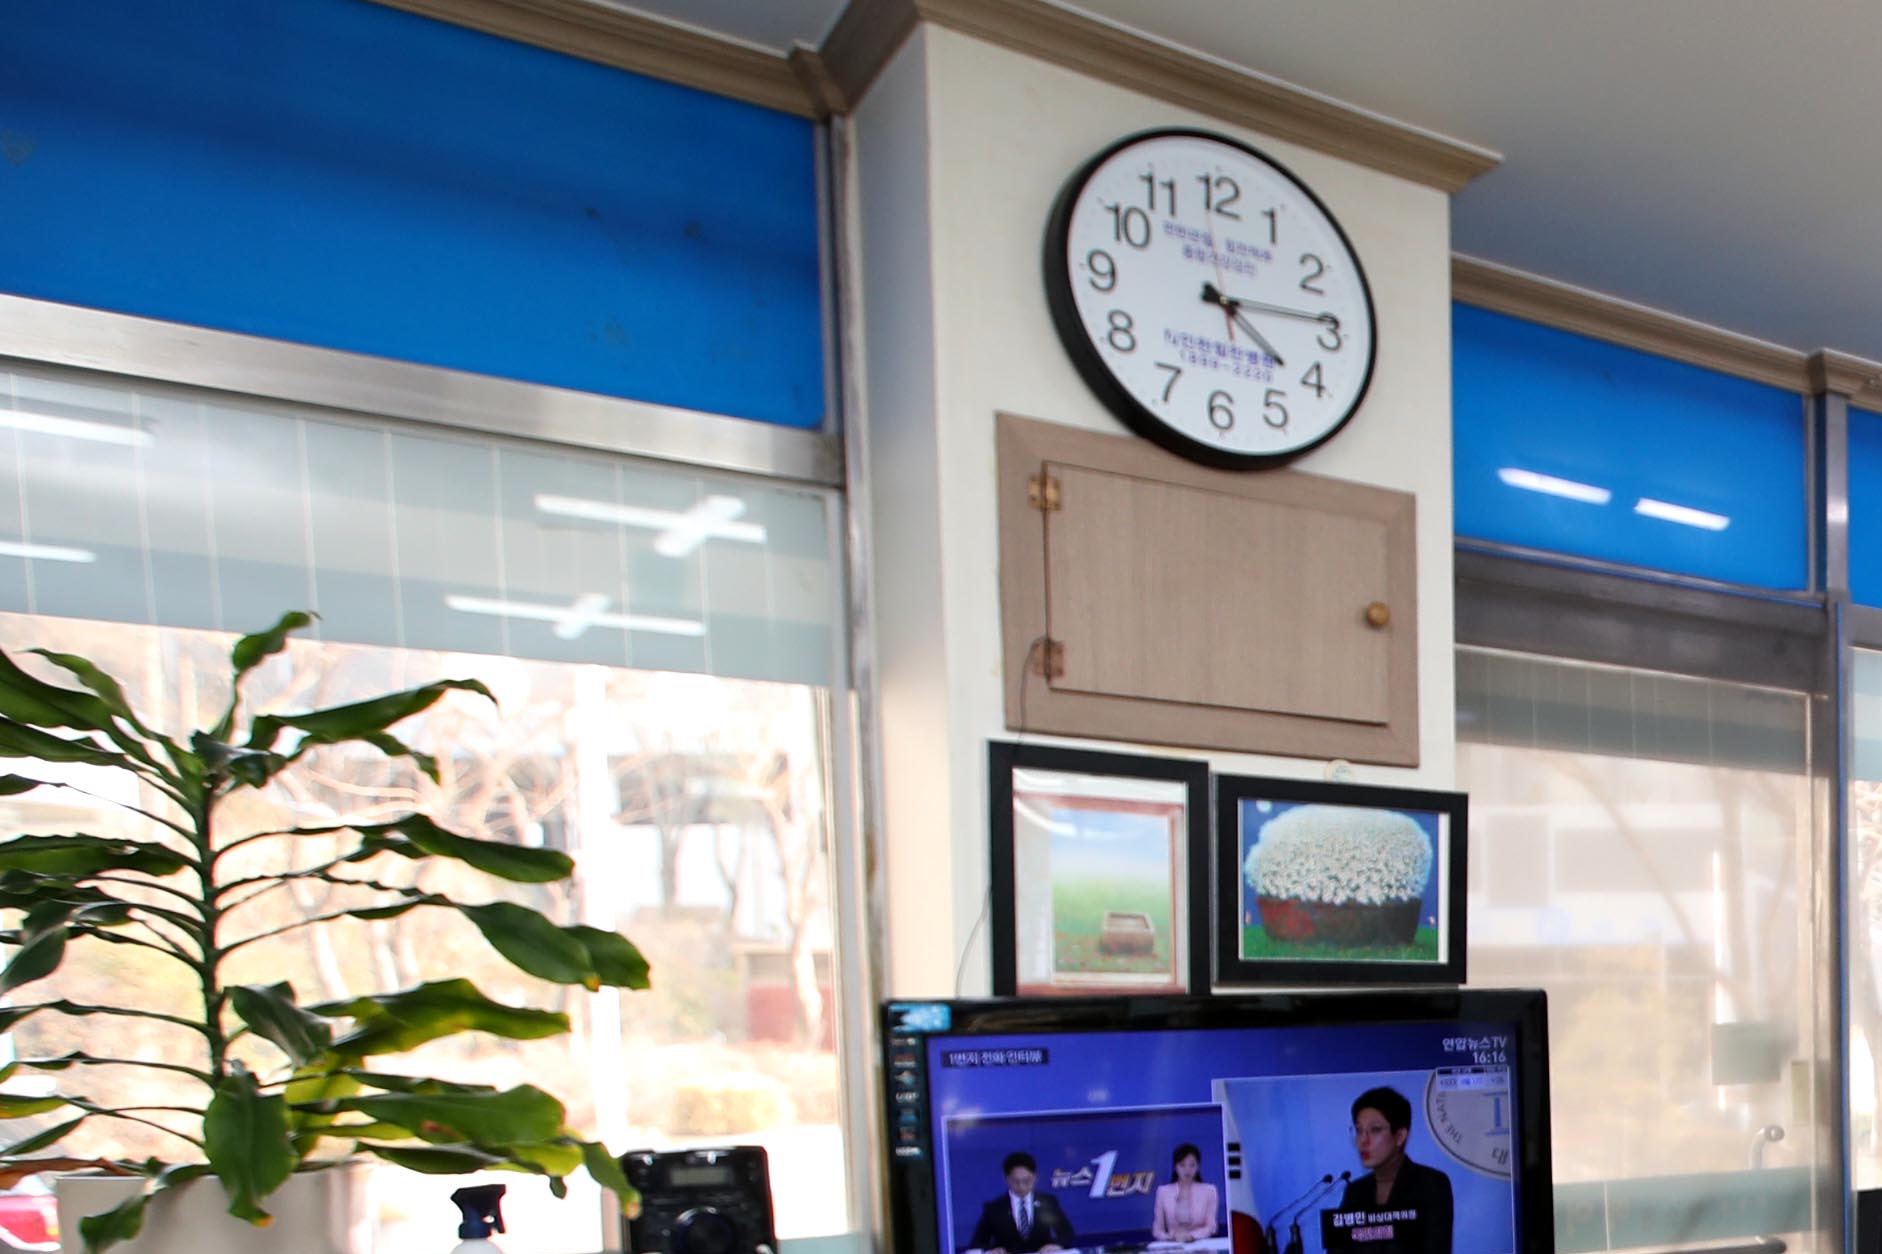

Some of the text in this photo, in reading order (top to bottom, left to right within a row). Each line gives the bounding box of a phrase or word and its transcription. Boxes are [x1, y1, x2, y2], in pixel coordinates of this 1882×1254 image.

[1140, 171, 1176, 217] 11
[1197, 171, 1241, 220] 12
[1105, 202, 1151, 248] 10
[1262, 208, 1277, 245] 1
[1088, 249, 1117, 293] 9
[1300, 254, 1325, 295] 2
[1108, 309, 1136, 352] 8
[1317, 312, 1342, 351] 3
[1155, 361, 1183, 403] 7
[1300, 362, 1327, 398] 4
[1208, 390, 1234, 431] 6
[1263, 389, 1288, 429] 5
[1442, 1036, 1507, 1051] 연합뉴스TV
[1472, 1051, 1507, 1063] 16:16
